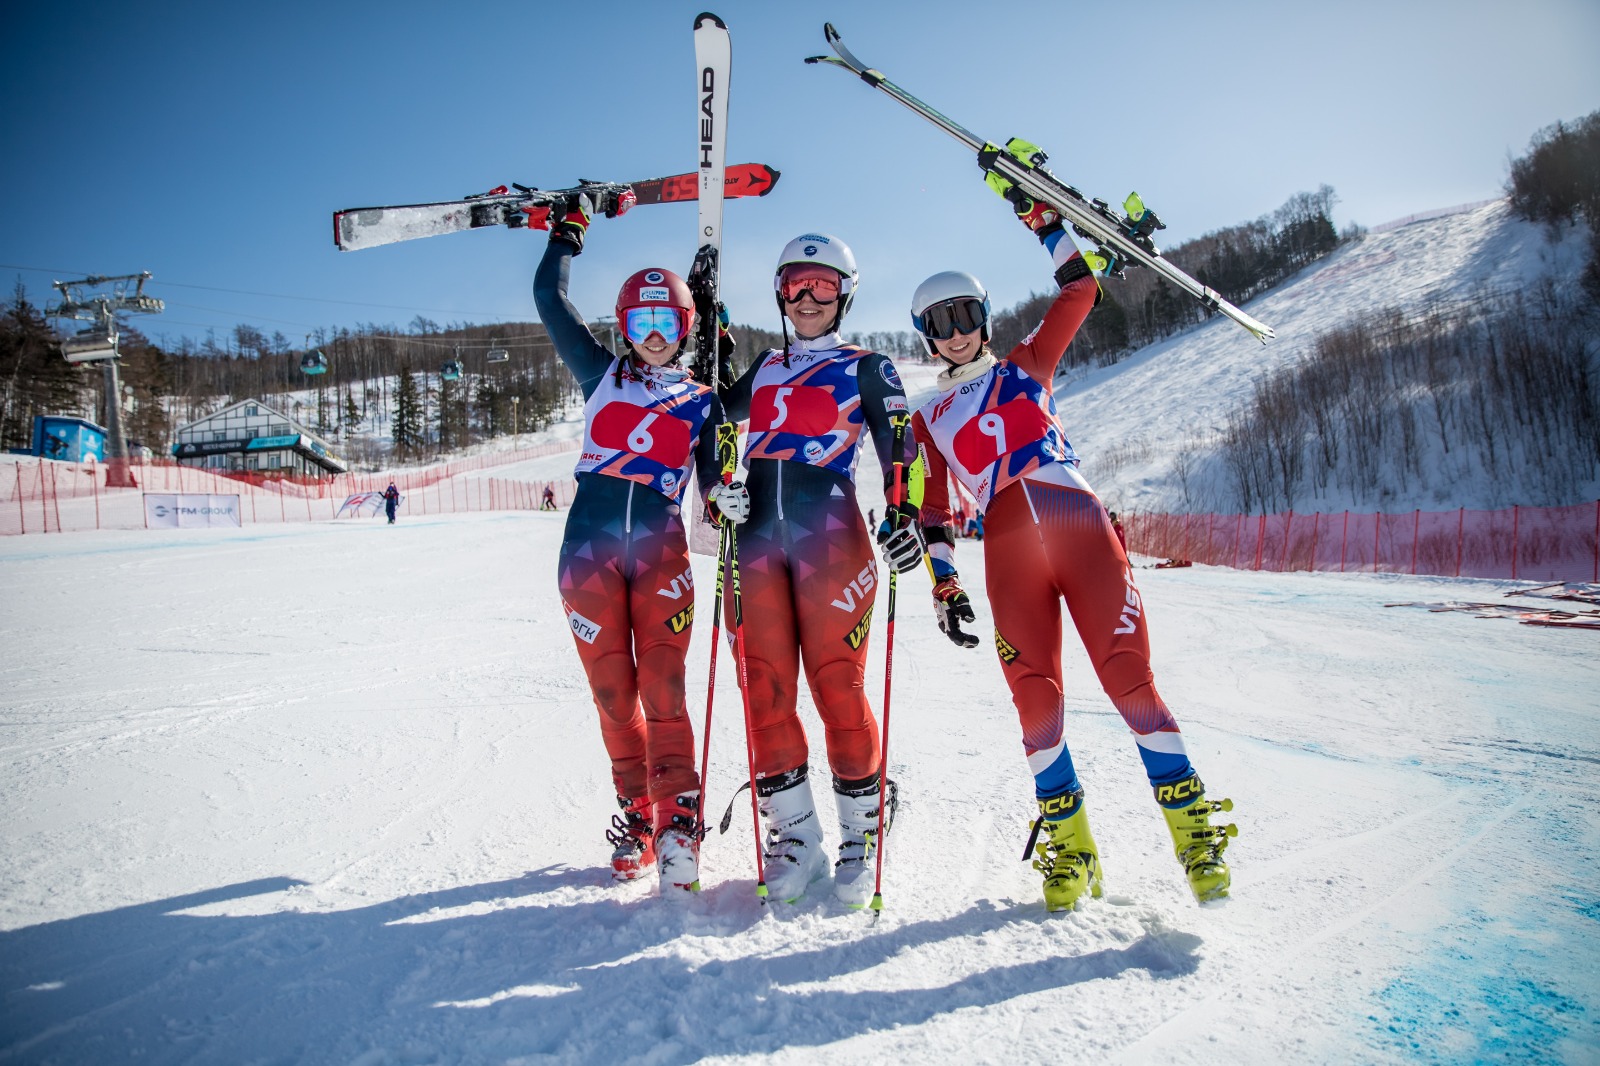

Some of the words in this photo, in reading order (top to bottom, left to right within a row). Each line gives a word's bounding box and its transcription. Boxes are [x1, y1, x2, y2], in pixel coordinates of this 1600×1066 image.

[701, 66, 714, 168] HEAD
[792, 354, 817, 363] ФГК
[769, 387, 794, 430] 5
[627, 412, 660, 453] 6
[978, 413, 1007, 457] 9
[715, 560, 725, 597] LEKI
[731, 560, 741, 595] LEKI
[572, 618, 596, 640] ФГК
[789, 810, 814, 828] HEAD
